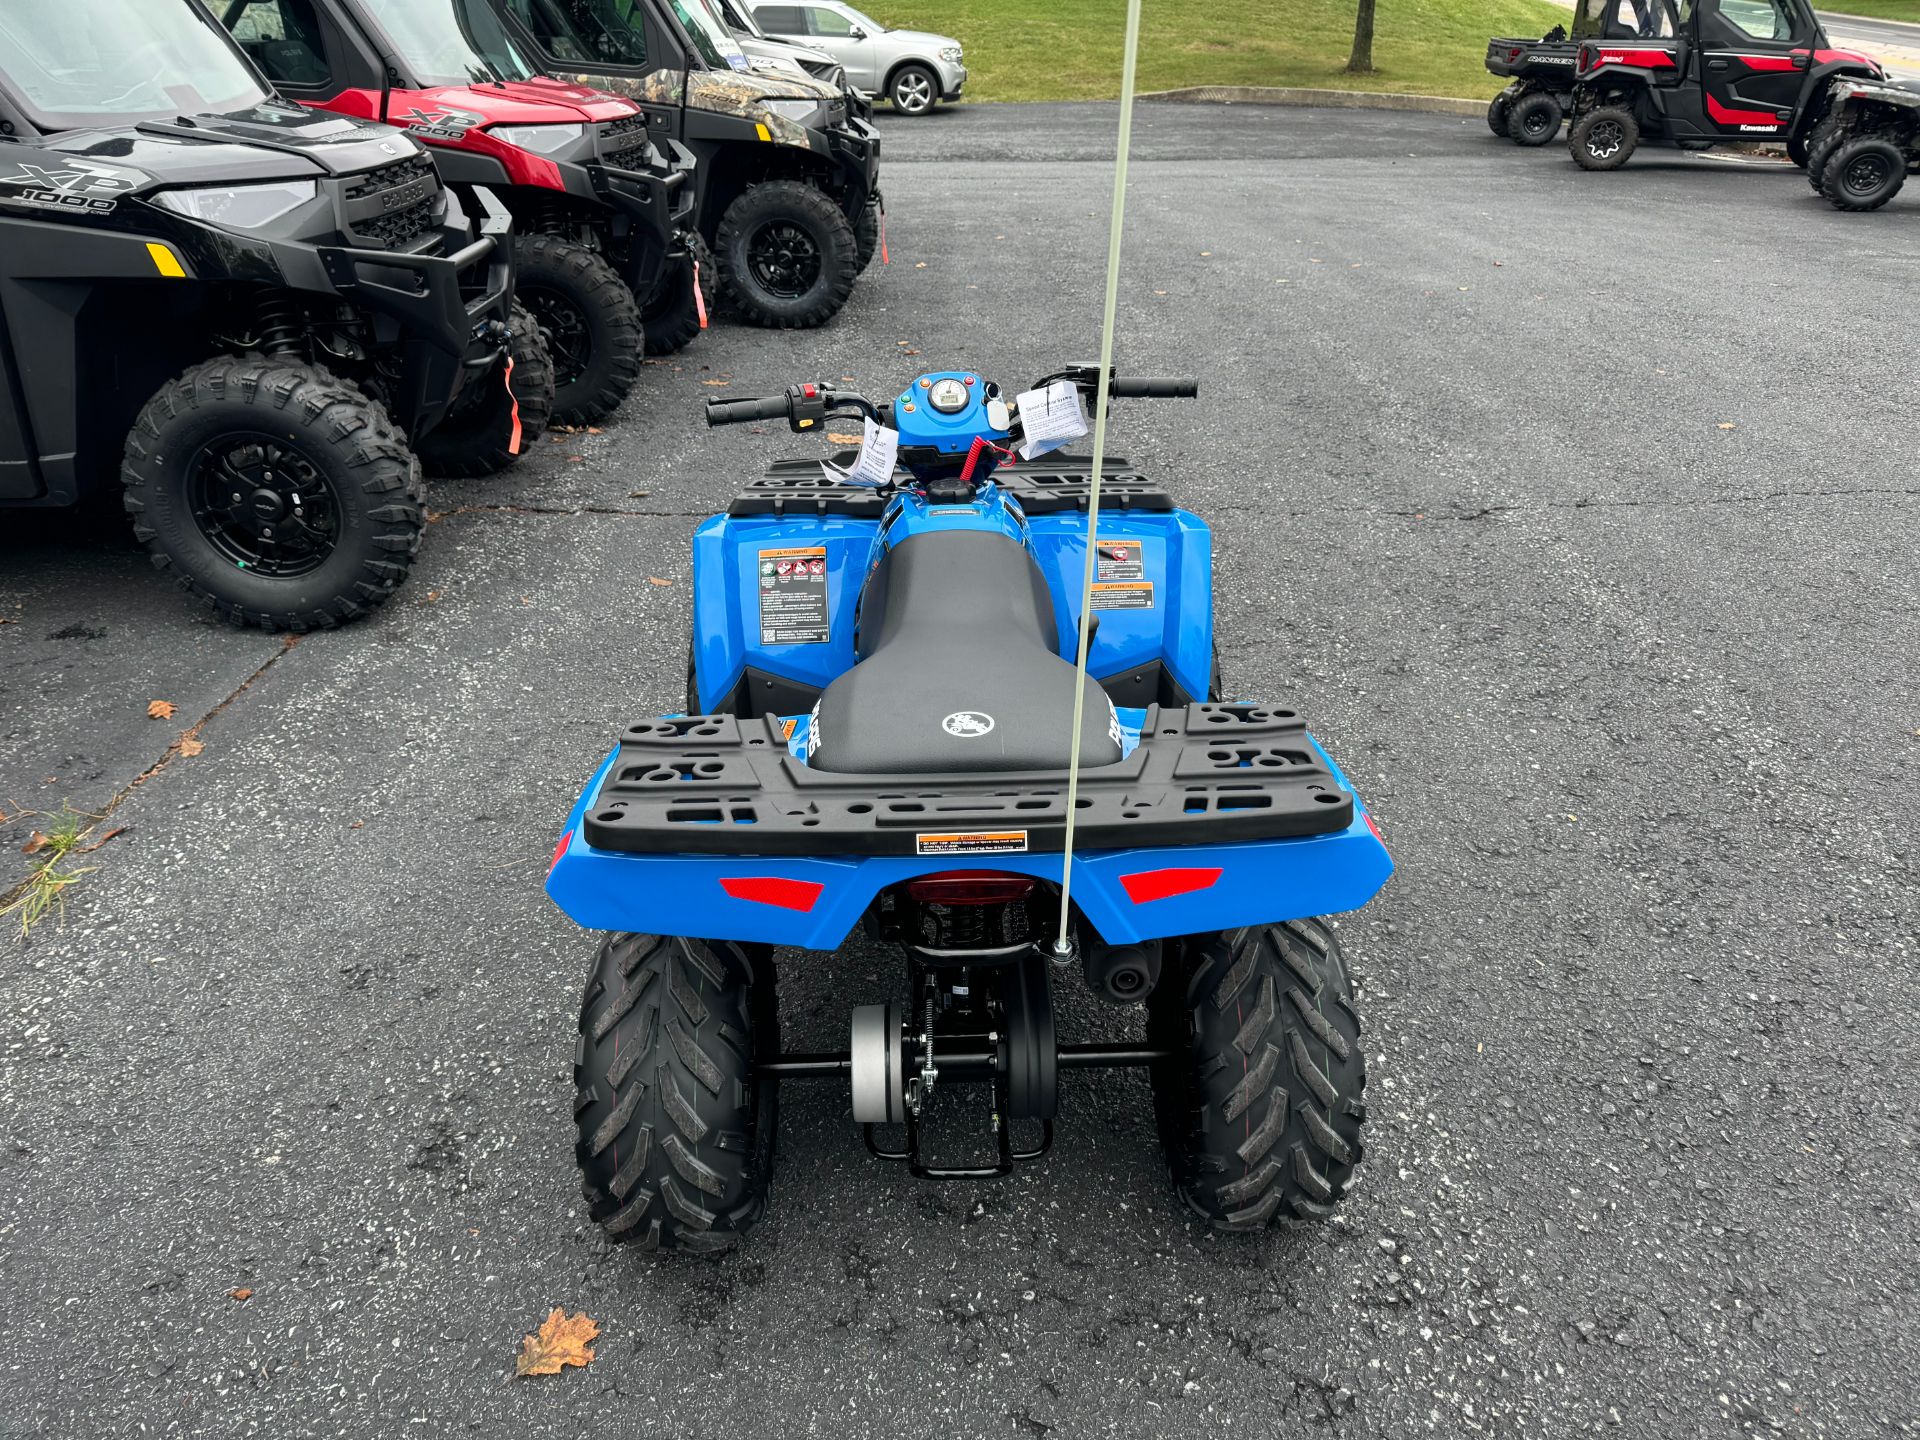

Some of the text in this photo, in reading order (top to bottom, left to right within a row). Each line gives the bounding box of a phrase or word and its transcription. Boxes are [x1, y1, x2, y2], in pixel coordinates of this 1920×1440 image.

[696, 91, 743, 105] 1000
[392, 107, 480, 127] XP
[408, 123, 466, 140] 1000
[1740, 124, 1777, 132] Kawasaki
[0, 162, 138, 193] XP
[22, 188, 117, 211] 1000
